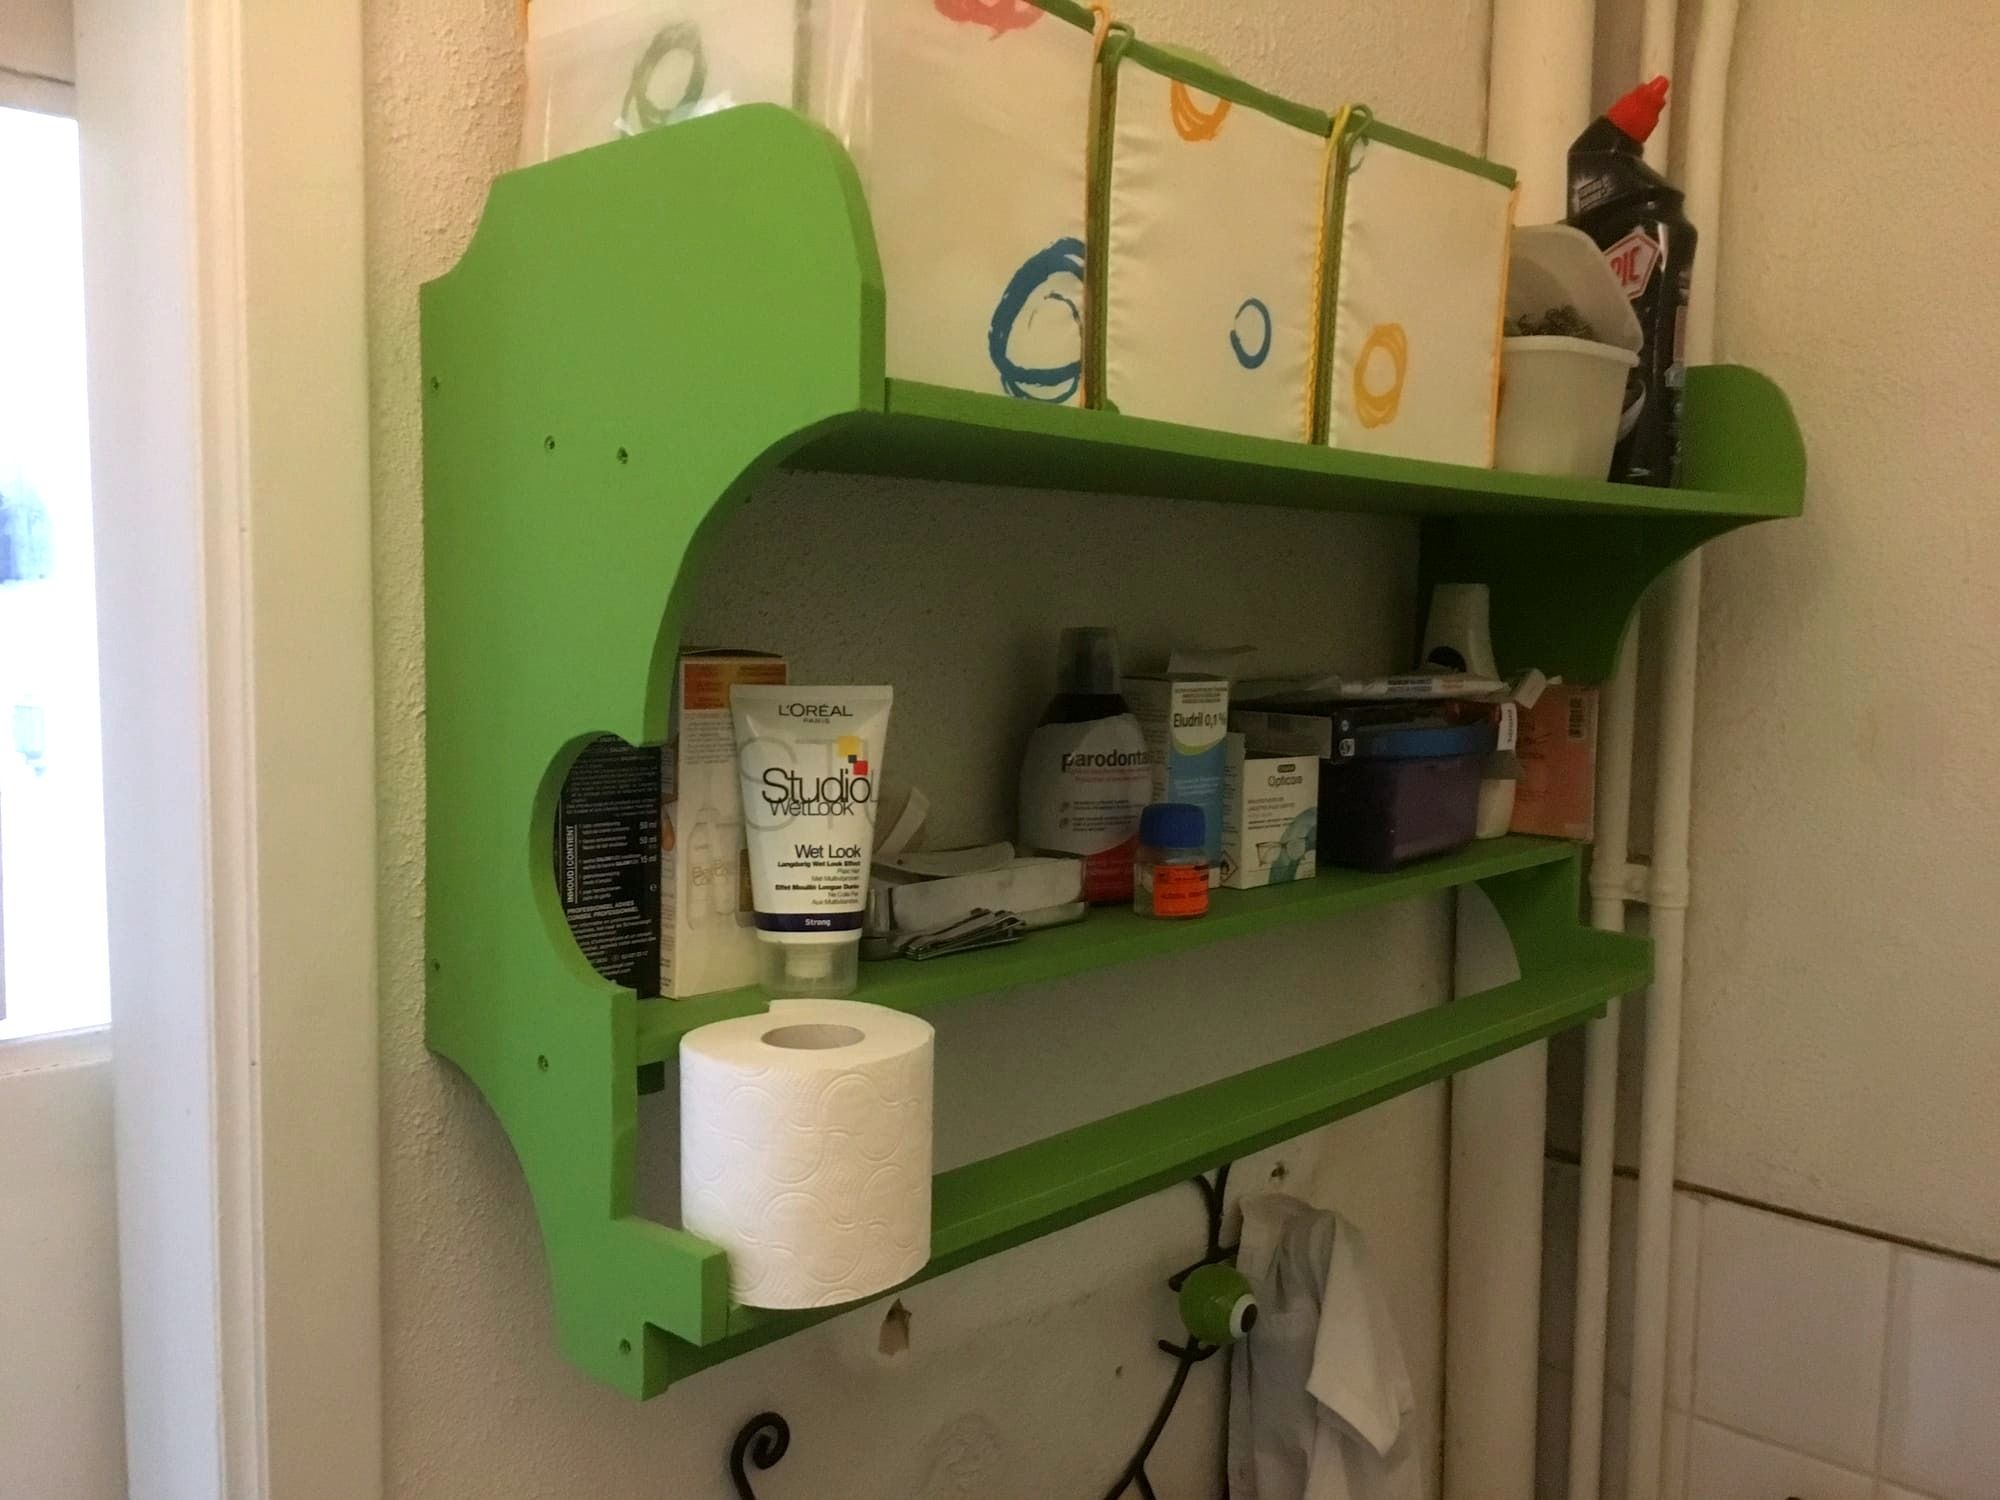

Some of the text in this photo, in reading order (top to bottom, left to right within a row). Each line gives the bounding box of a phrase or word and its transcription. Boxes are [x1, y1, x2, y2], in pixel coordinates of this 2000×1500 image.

[778, 703, 853, 717] L'ORÉAL
[1173, 712, 1203, 728] Eludril
[762, 767, 871, 804] Studio
[794, 843, 861, 859] Wet Look
[804, 918, 831, 927] Strong
